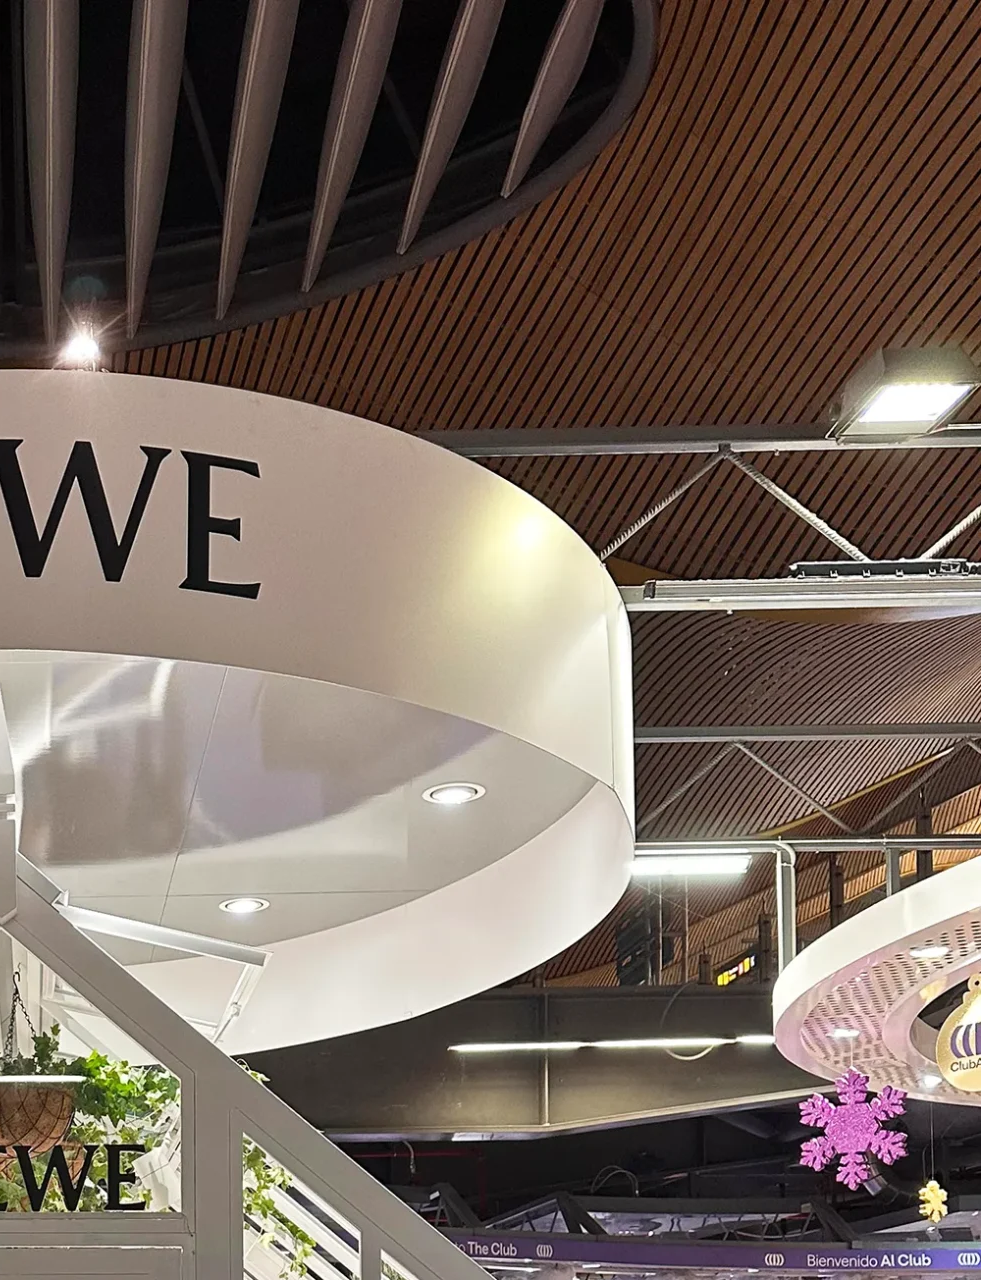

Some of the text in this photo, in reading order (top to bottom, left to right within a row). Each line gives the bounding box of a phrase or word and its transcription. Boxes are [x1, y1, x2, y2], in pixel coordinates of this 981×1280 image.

[467, 1241, 489, 1255] The
[490, 1242, 518, 1256] Club
[807, 1253, 932, 1268] Bienvenido Al Club
